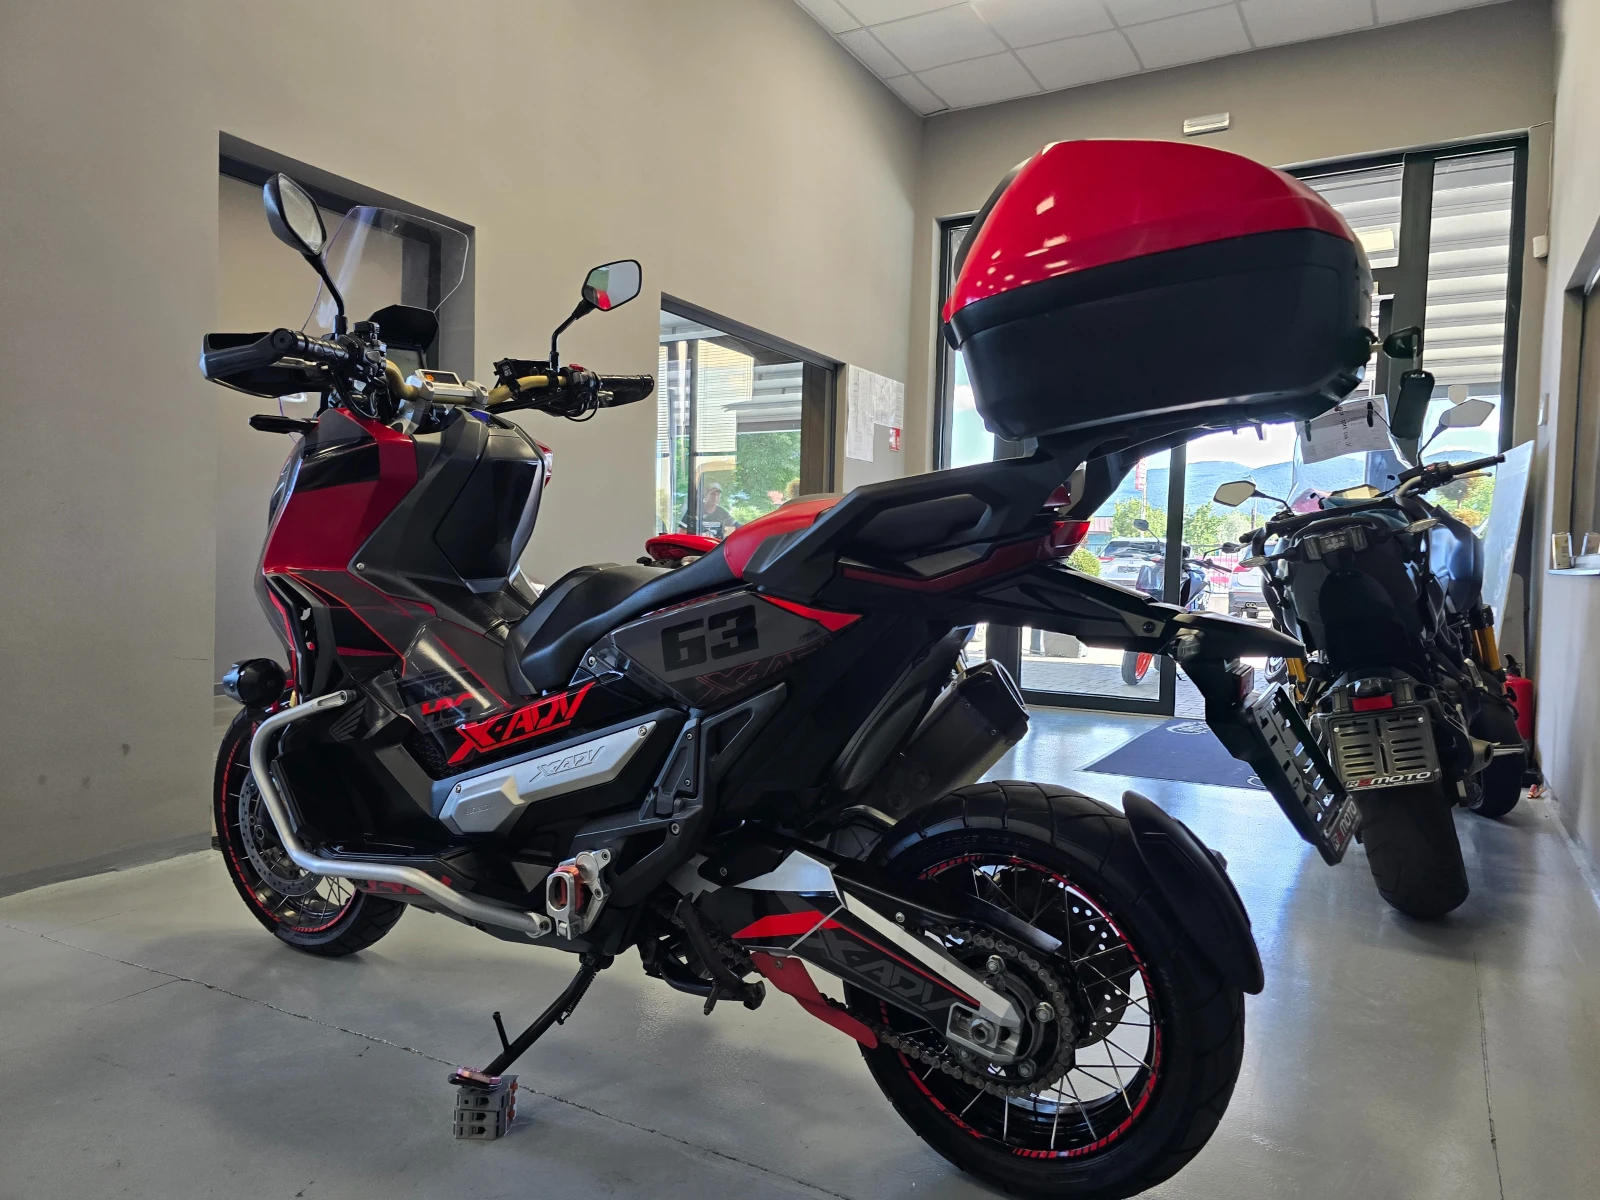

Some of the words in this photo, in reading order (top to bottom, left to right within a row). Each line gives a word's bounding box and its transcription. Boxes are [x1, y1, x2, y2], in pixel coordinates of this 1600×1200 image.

[661, 604, 760, 673] 63
[424, 680, 453, 697] NGK
[448, 681, 596, 765] X-ADV
[529, 745, 605, 783] X-ADV
[790, 926, 957, 1012] X-ADV
